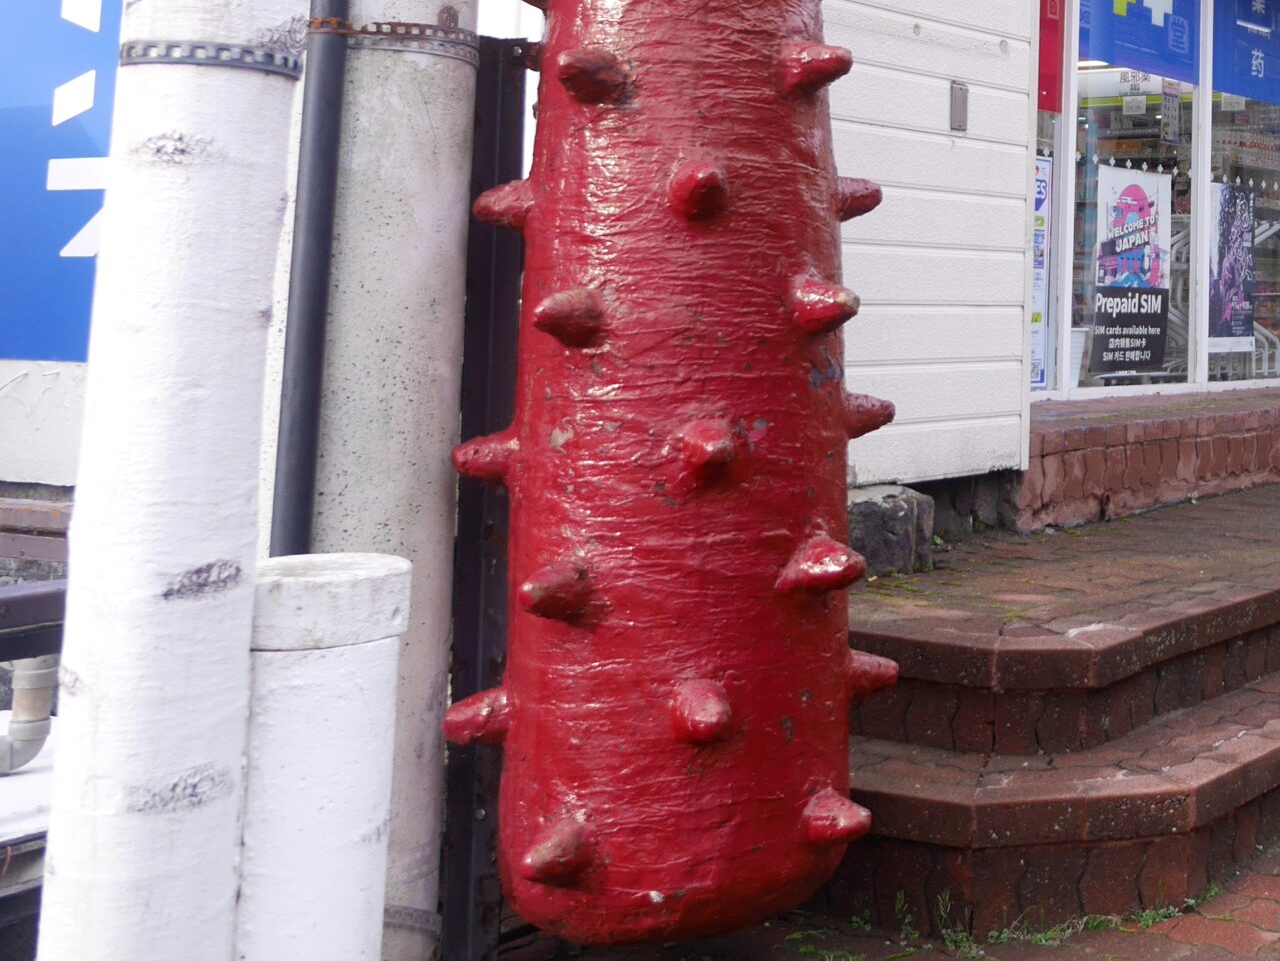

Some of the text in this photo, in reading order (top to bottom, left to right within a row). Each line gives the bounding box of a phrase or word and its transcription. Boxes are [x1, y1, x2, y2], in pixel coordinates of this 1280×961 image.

[1107, 215, 1155, 239] WELCOME TO
[1115, 230, 1149, 253] JAPAN
[1095, 291, 1162, 318] Prepaid SIM
[1094, 325, 1161, 335] SIM cards available here
[1103, 351, 1113, 361] SIM
